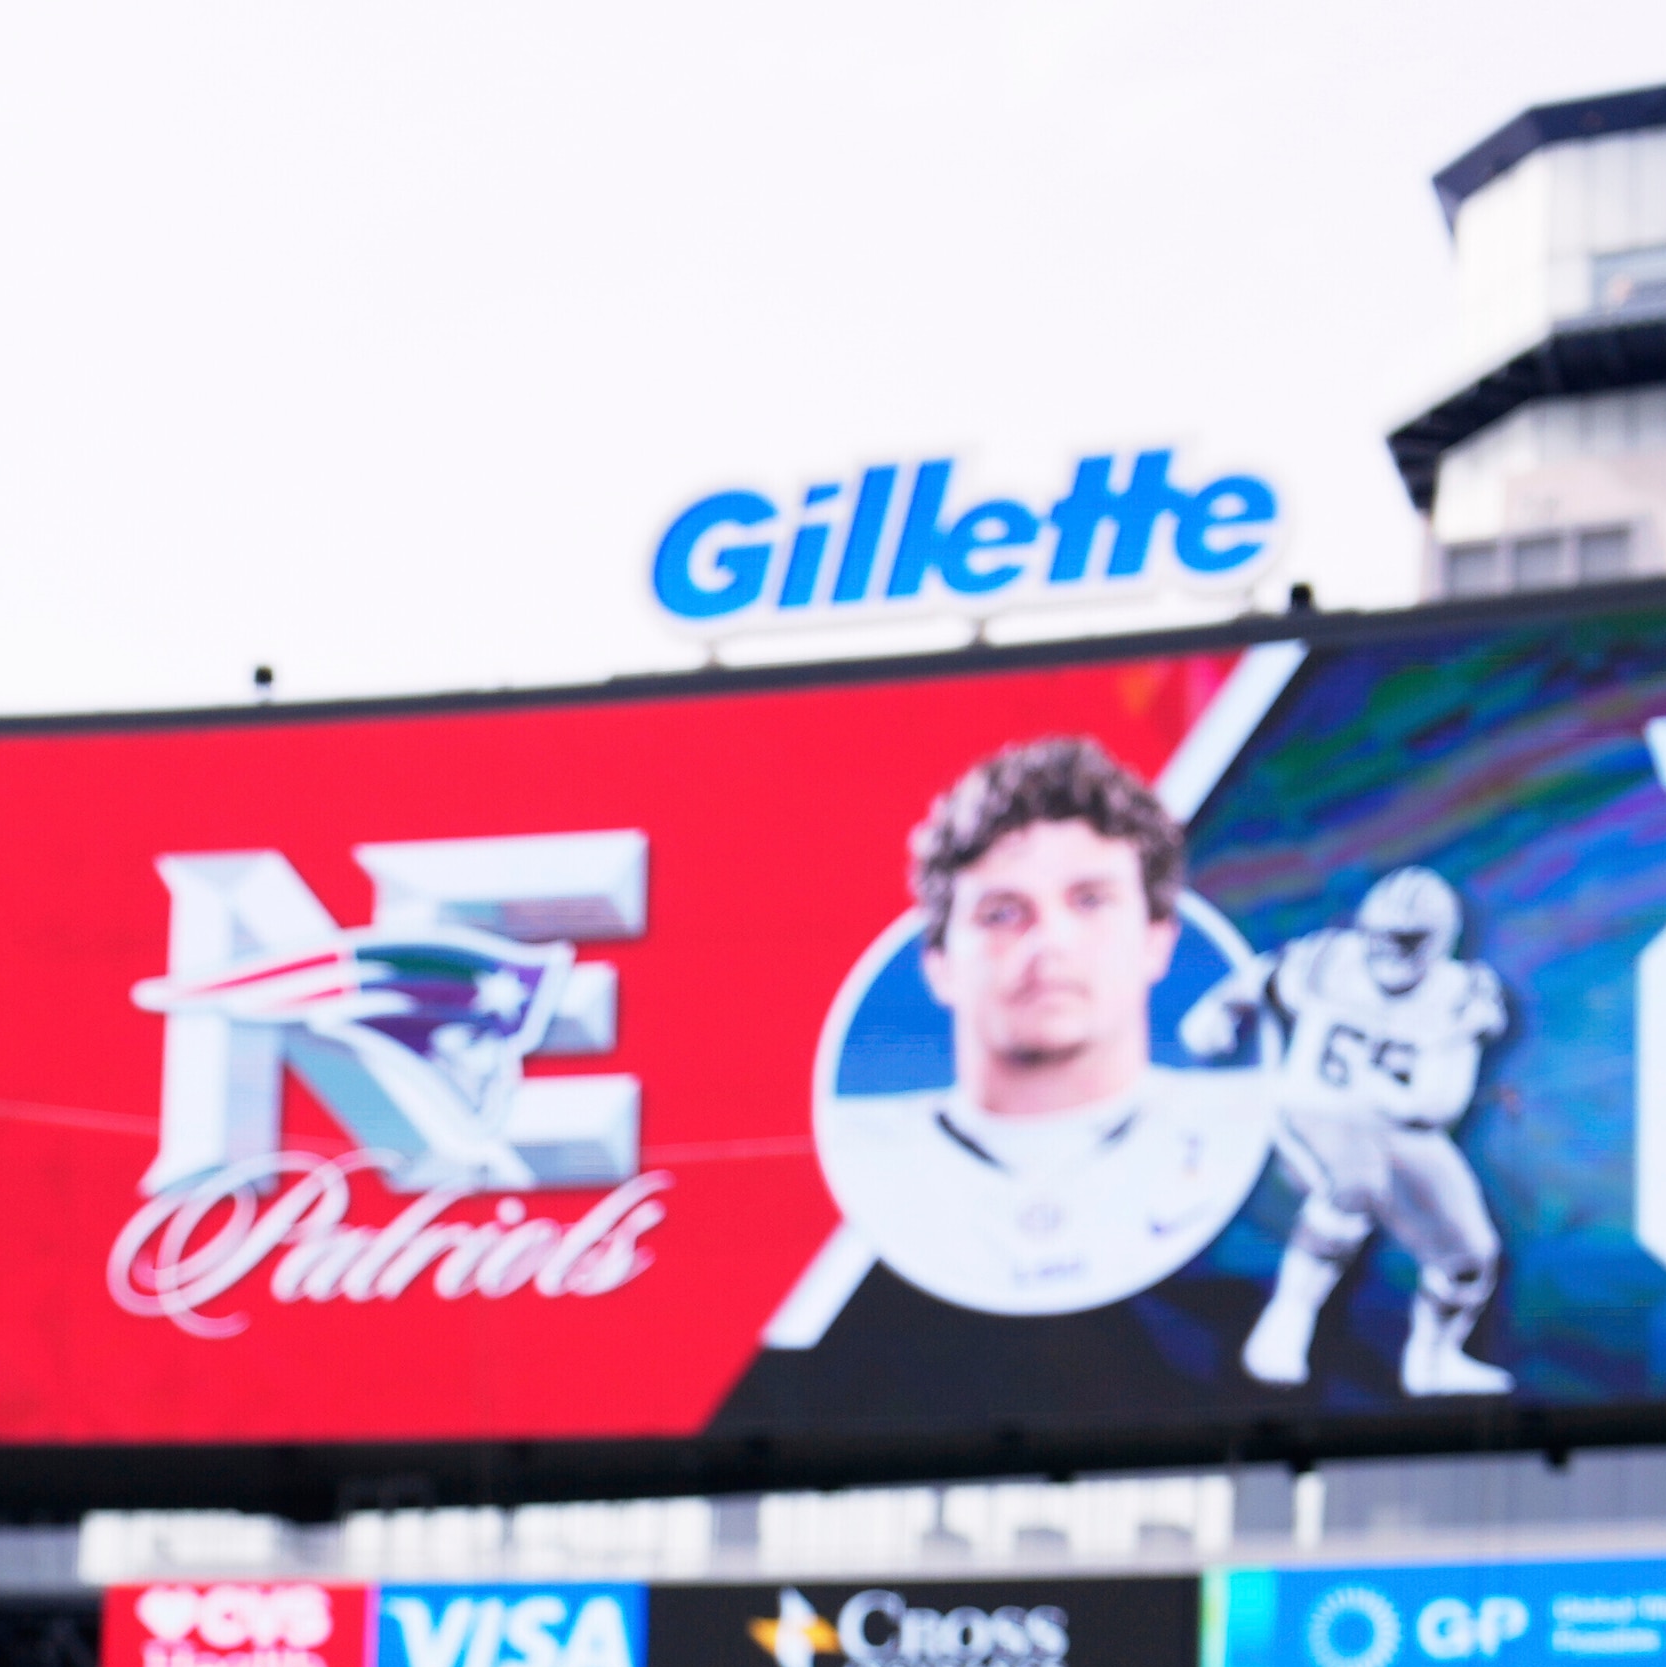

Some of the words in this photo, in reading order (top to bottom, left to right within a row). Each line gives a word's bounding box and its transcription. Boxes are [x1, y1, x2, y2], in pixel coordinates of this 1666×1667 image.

[650, 448, 1279, 620] Gillette
[107, 1148, 674, 1338] Patriots
[1416, 1596, 1531, 1660] GP
